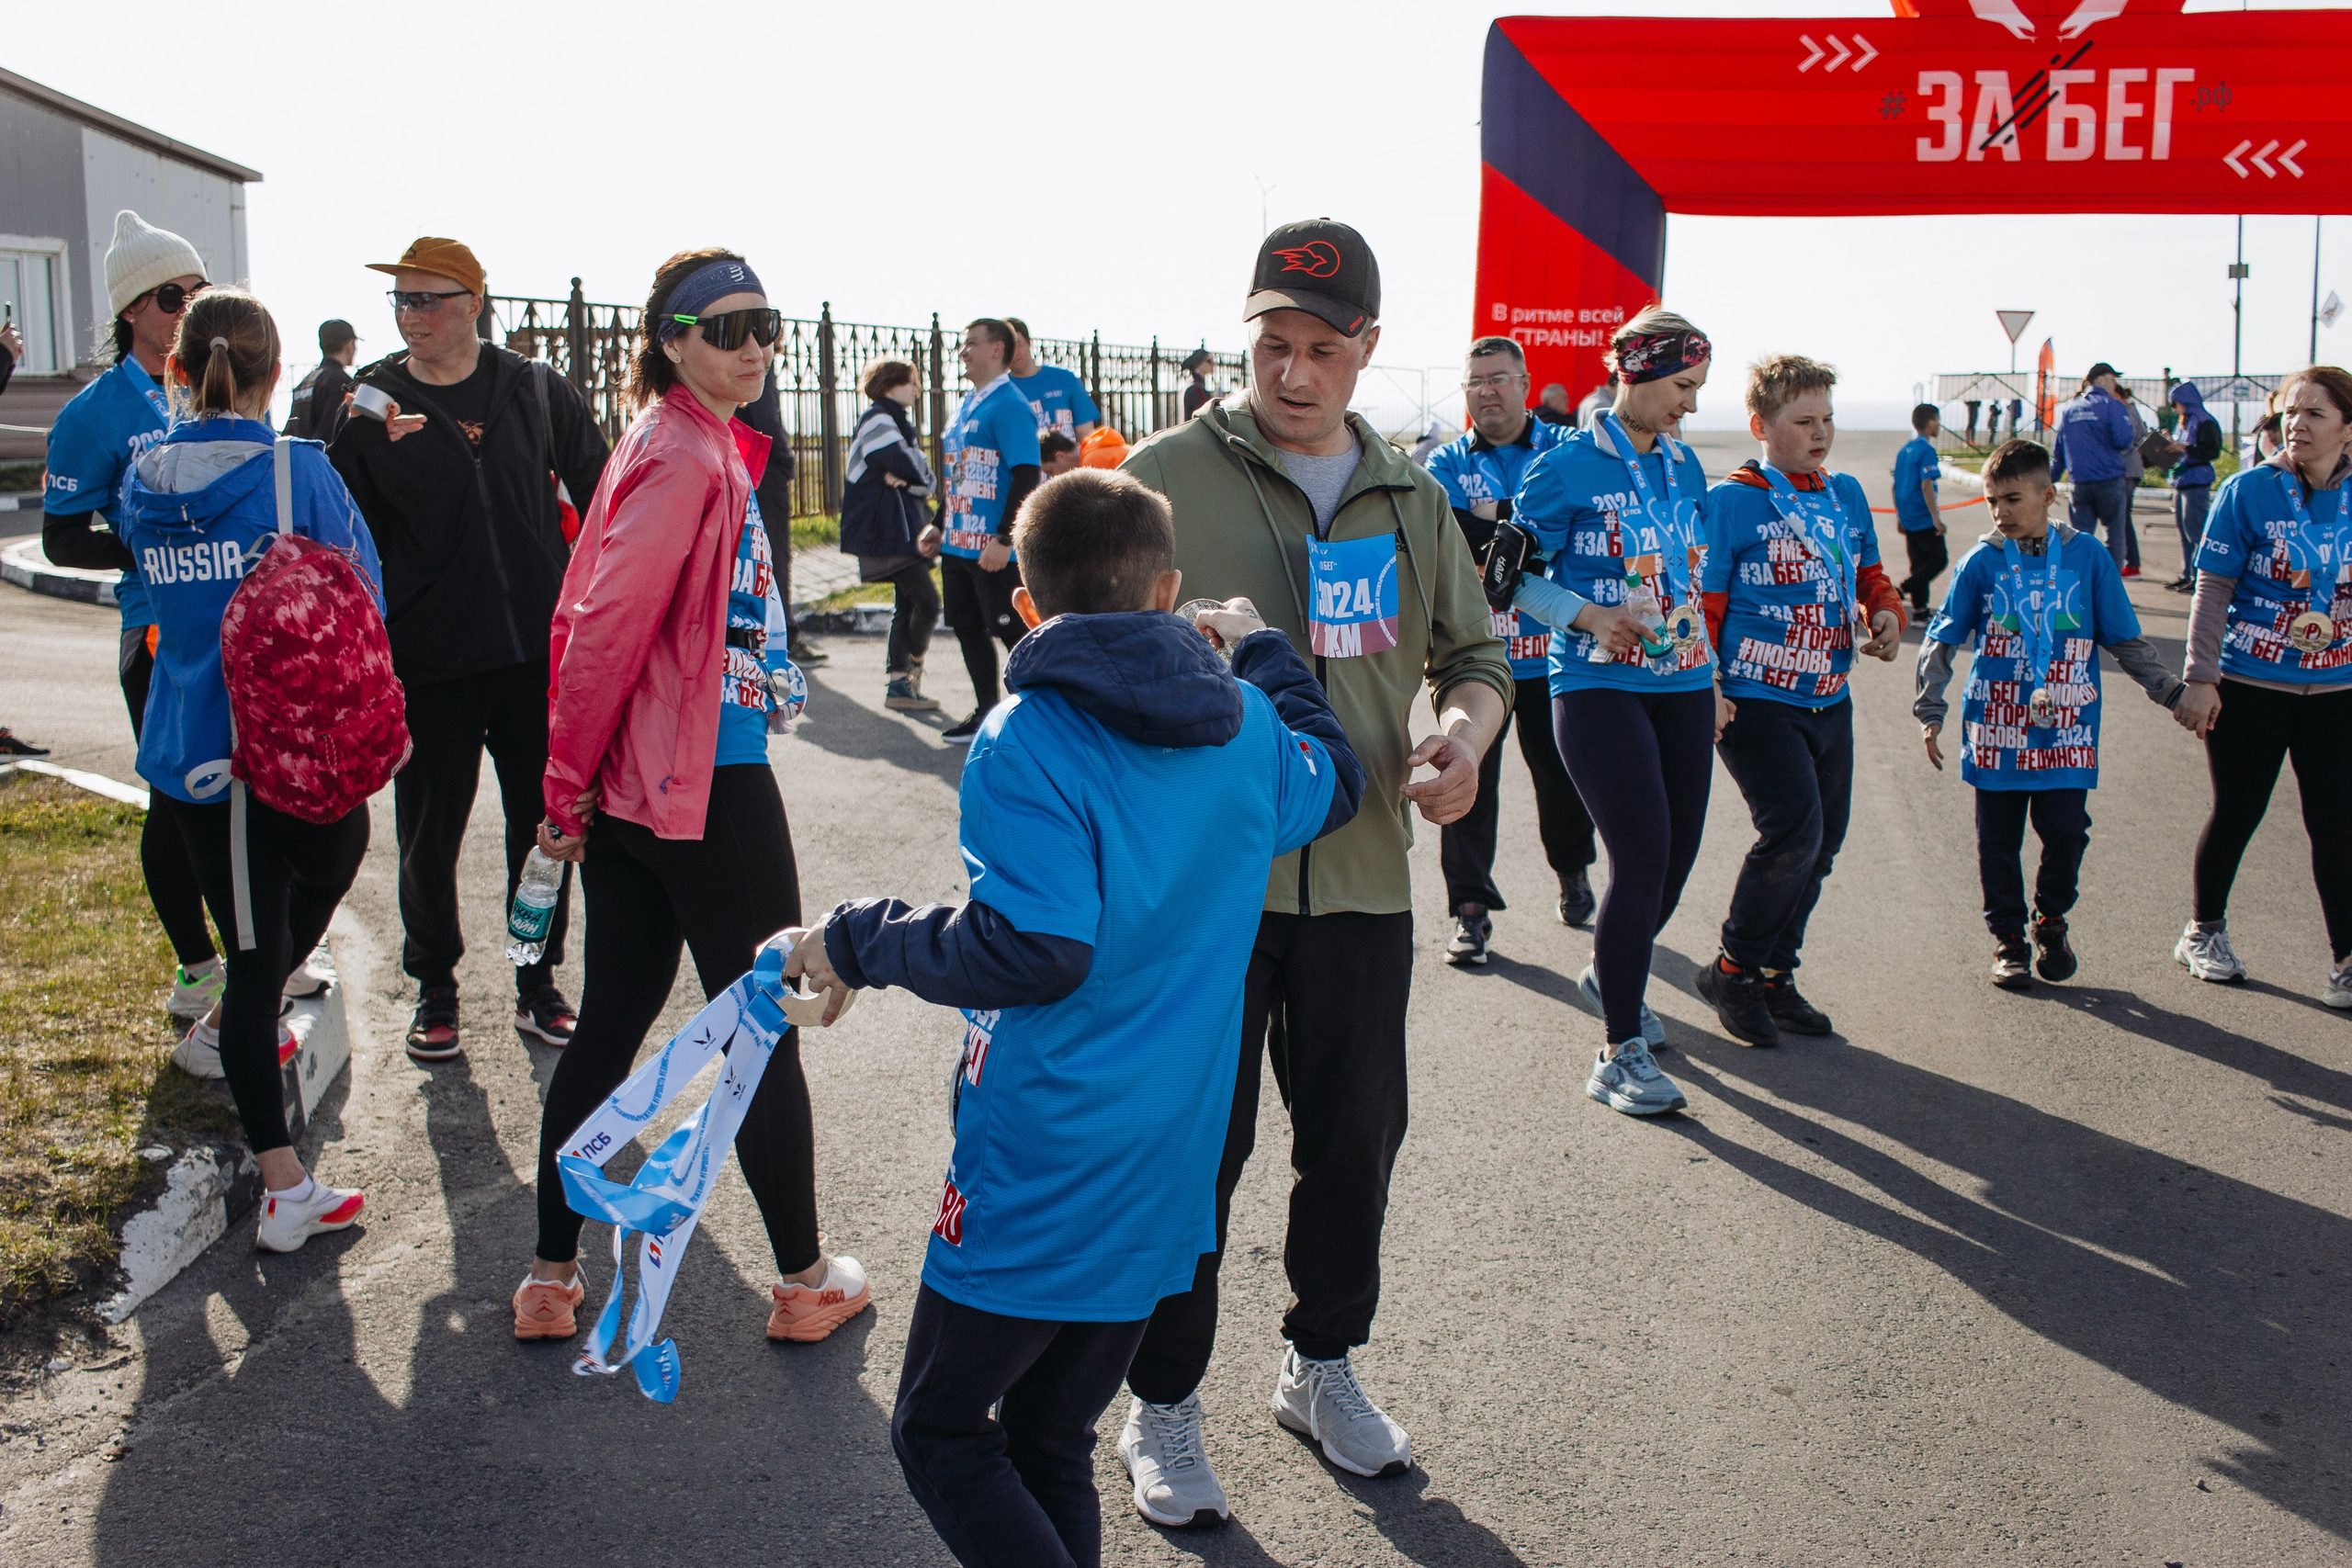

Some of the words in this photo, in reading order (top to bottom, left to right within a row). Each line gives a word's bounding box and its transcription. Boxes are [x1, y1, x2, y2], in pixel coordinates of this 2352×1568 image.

[1492, 302, 1508, 321] В
[1510, 307, 1574, 323] ритме
[1577, 305, 1624, 323] всей
[1510, 327, 1604, 347] СТРАНЫ!
[1634, 470, 1646, 489] ПСБ
[143, 540, 246, 585] RUSSIA
[1737, 637, 1832, 674] #ЛЮБОВЬ
[1728, 659, 1800, 691] #ЗАБЕГ
[582, 1132, 612, 1159] ПСБ
[818, 1289, 845, 1306] HOKA
